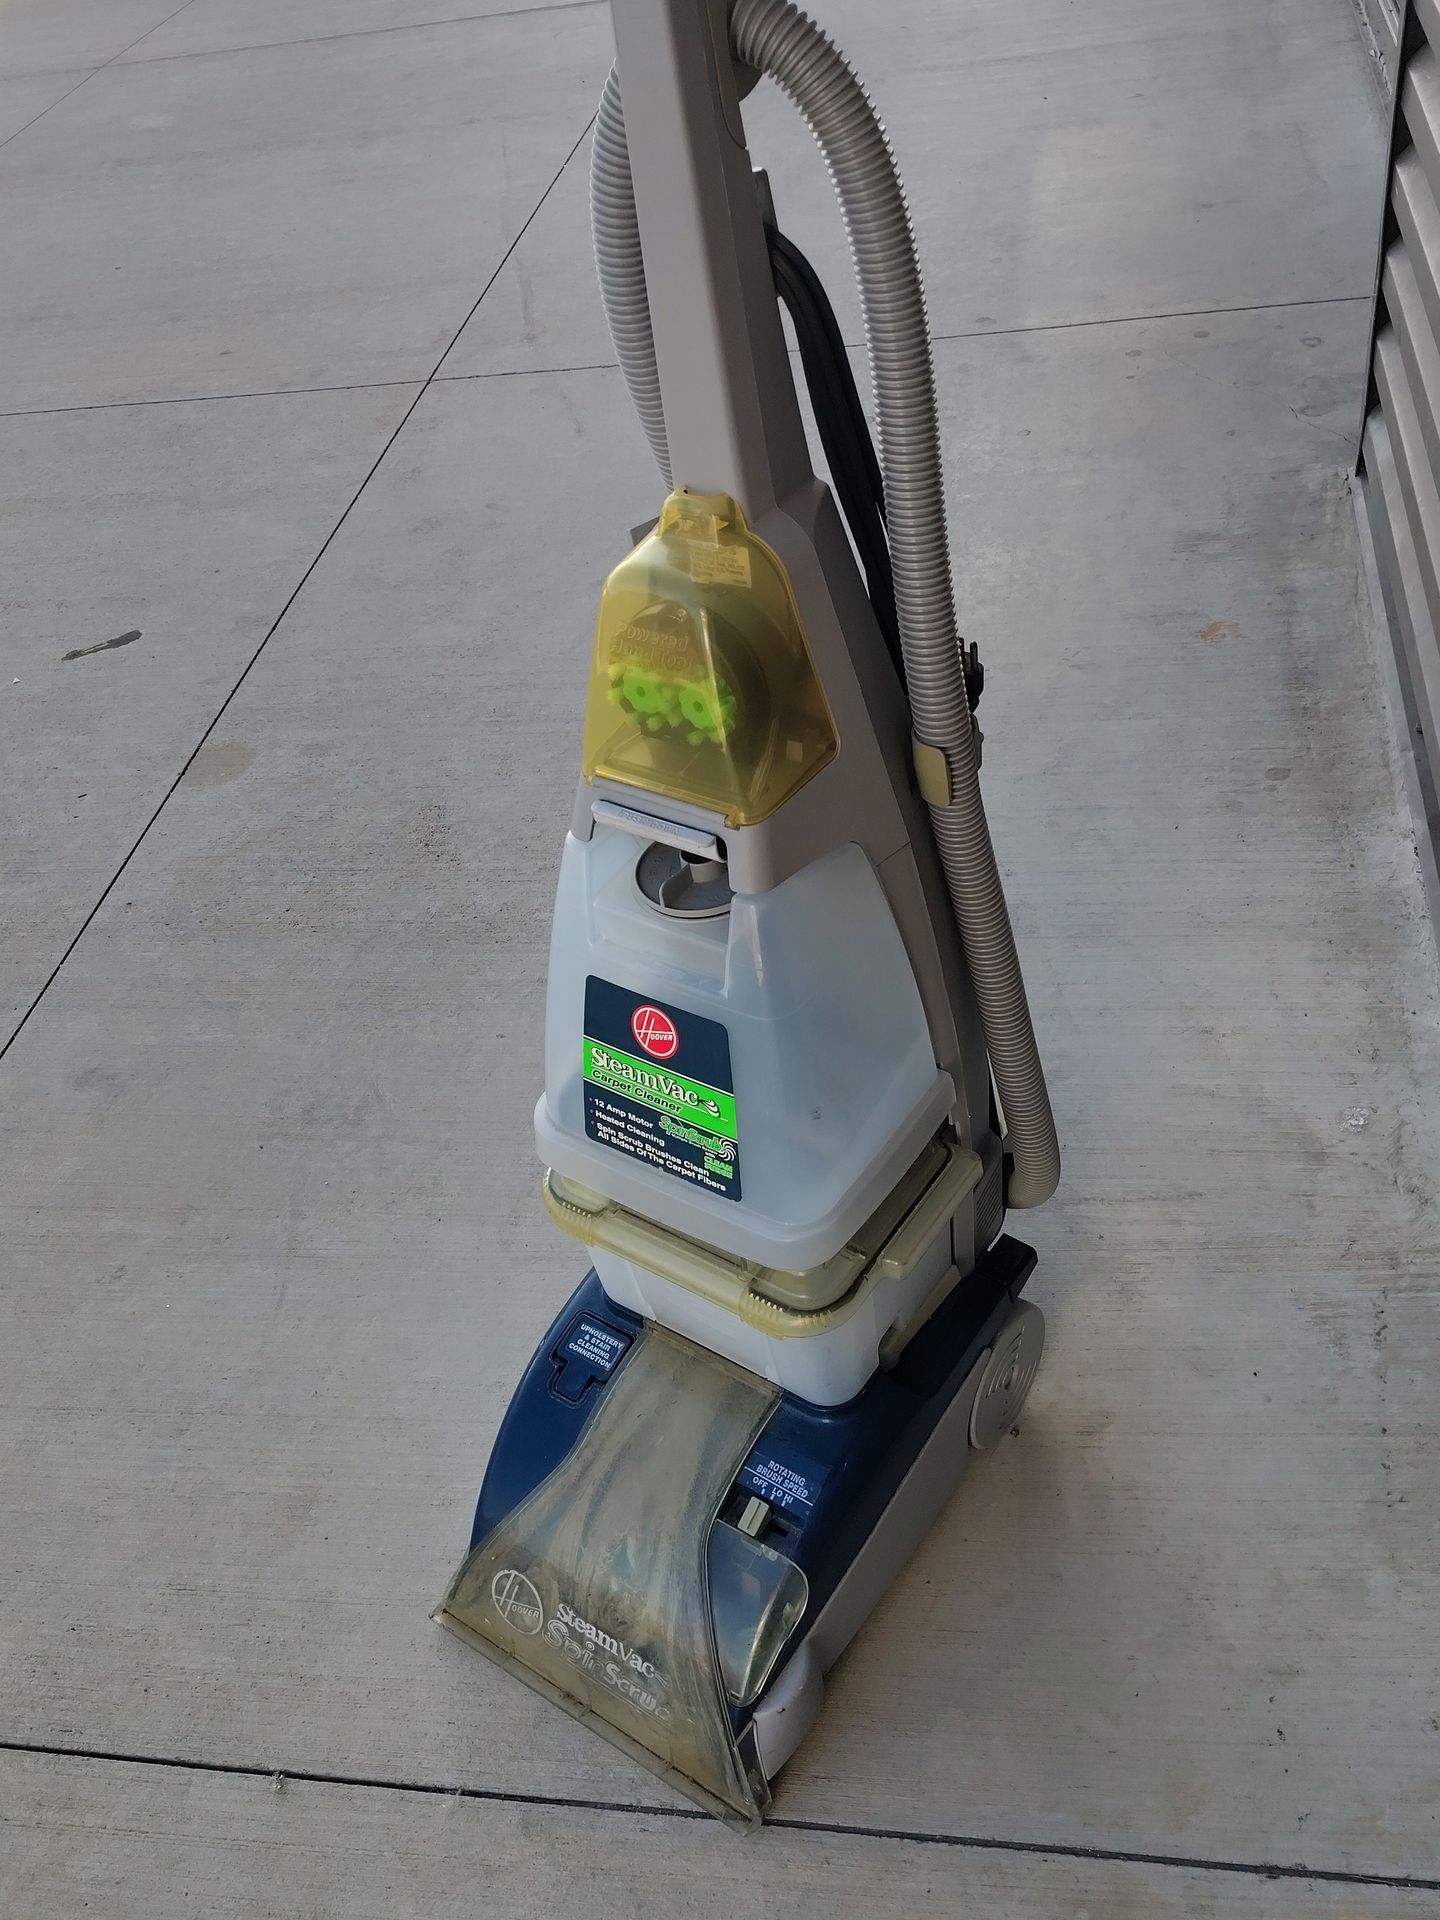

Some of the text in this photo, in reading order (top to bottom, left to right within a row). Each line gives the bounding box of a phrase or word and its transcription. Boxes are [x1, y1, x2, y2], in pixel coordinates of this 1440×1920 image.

[591, 1047, 699, 1106] SteamVac
[592, 1069, 682, 1112] Carpet Cleaner
[594, 1099, 653, 1128] 12 Amp Motor
[595, 1110, 625, 1128] Heated
[627, 1123, 665, 1147] Cleaning
[596, 1122, 616, 1137] Spin
[618, 1131, 643, 1148] Scrub
[645, 1143, 682, 1165] Brushes
[683, 1160, 709, 1177] Clean
[597, 1130, 726, 1192] All Sides Of The Carpet Fibers
[577, 1338, 610, 1360] CLEANING
[581, 1323, 624, 1350] UPHOLSTERY
[568, 1342, 611, 1369] CONNECTION
[752, 1476, 794, 1504] OFF LO HI
[755, 1464, 809, 1498] BRUSH SPEED
[767, 1460, 806, 1486] ROTATING
[557, 1602, 655, 1679] SteamVac
